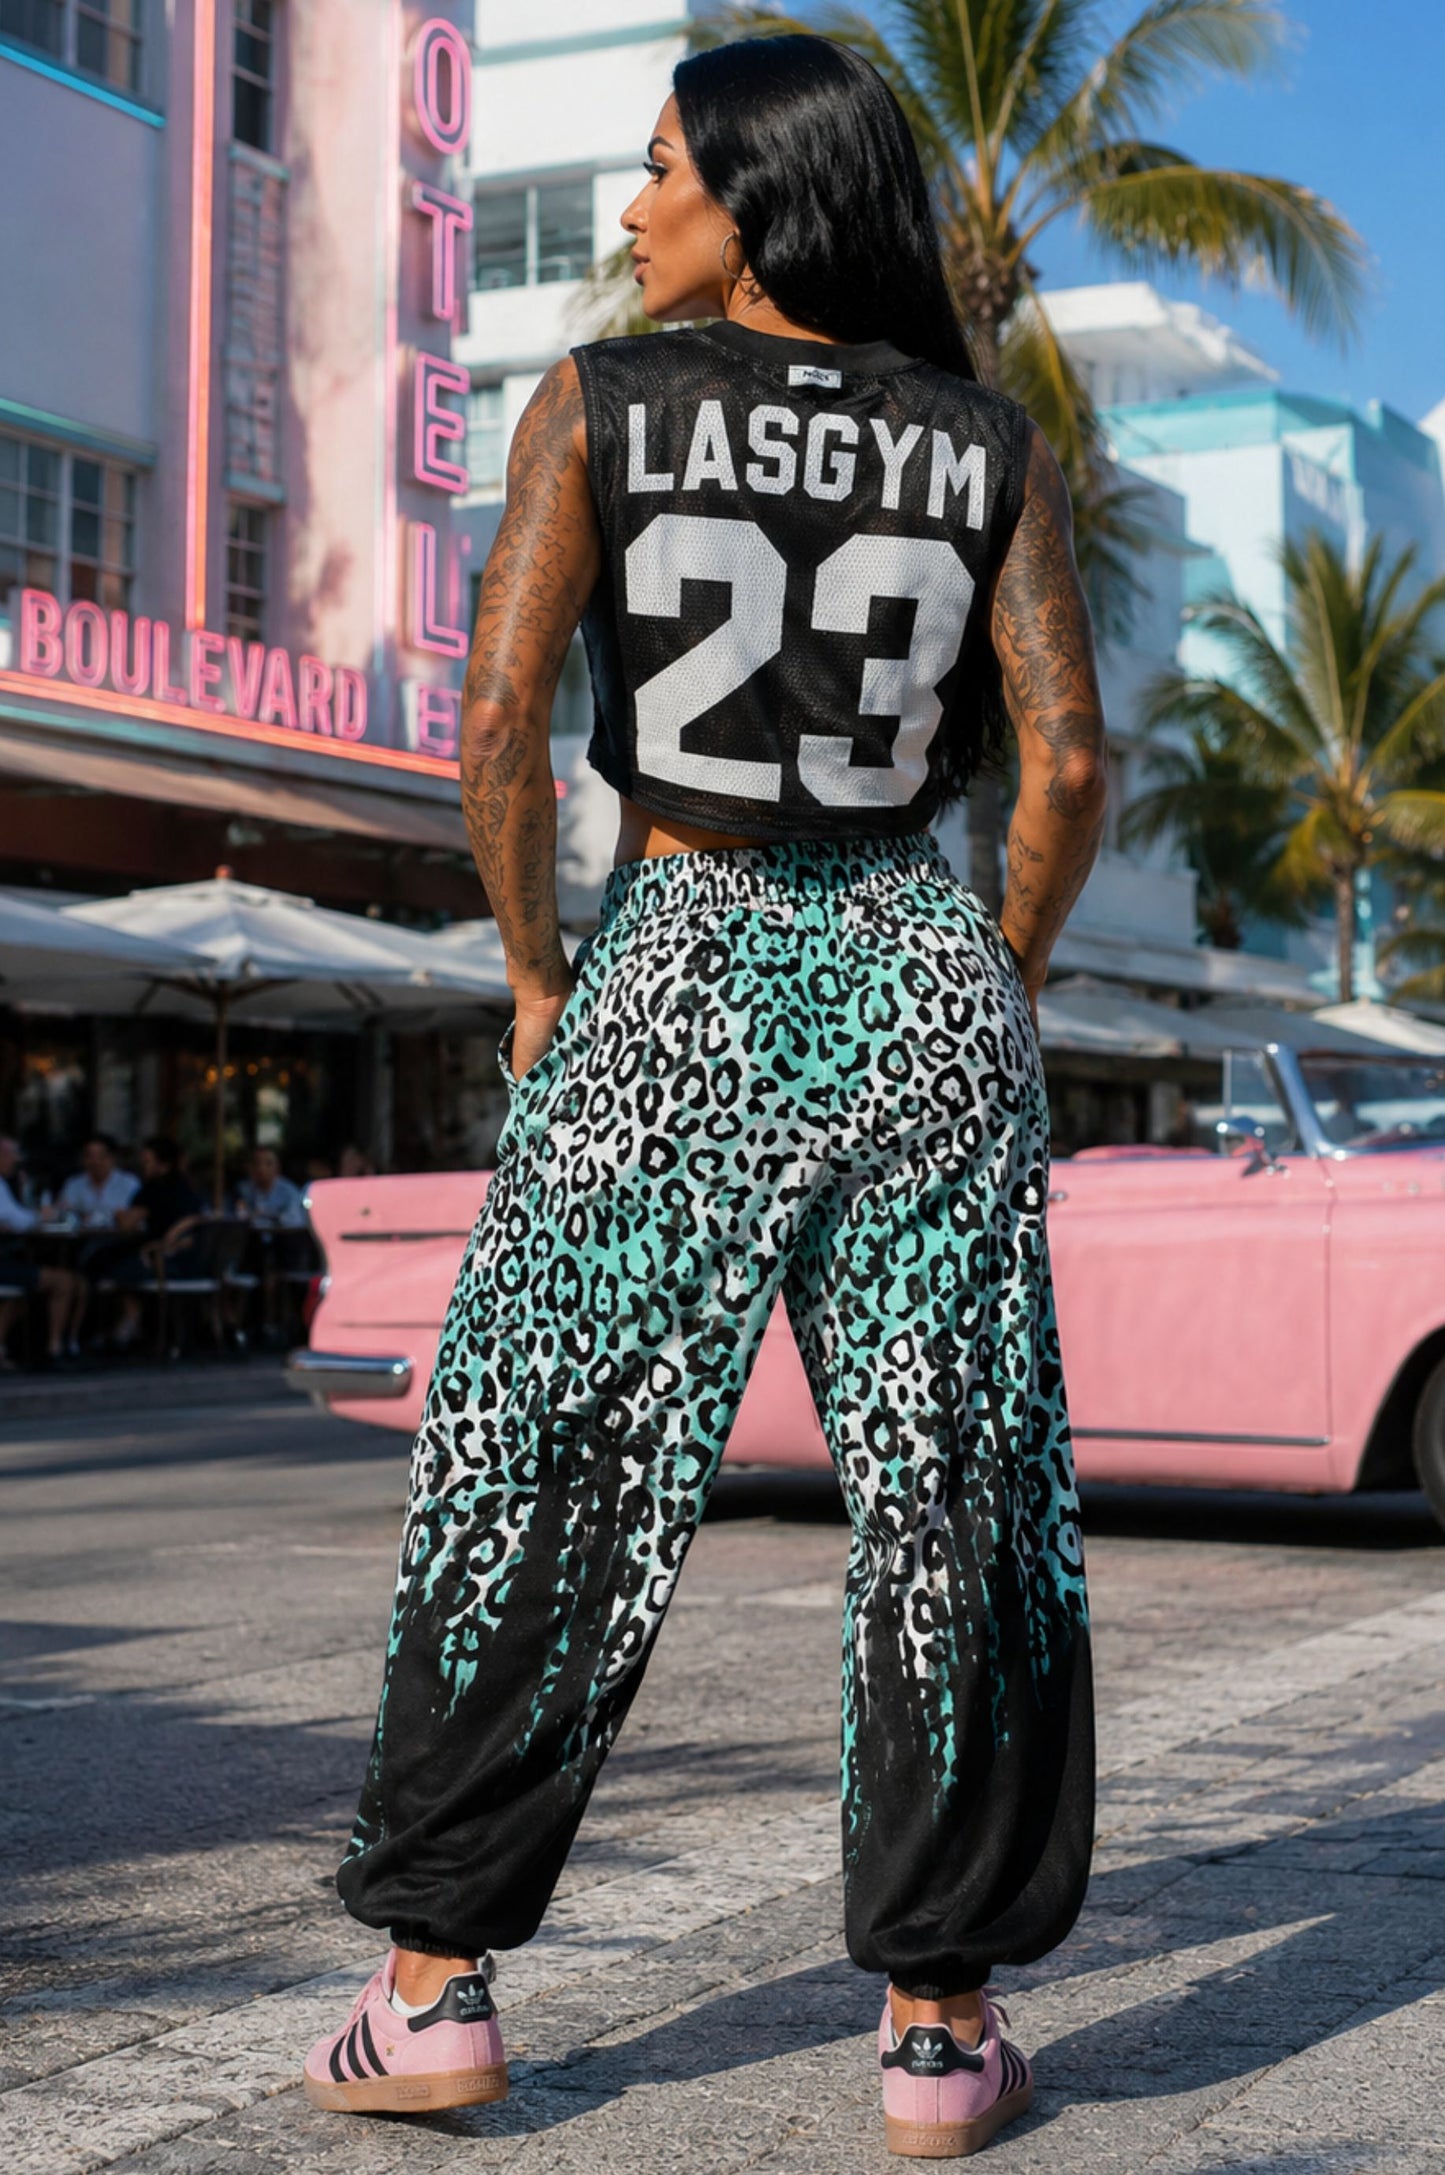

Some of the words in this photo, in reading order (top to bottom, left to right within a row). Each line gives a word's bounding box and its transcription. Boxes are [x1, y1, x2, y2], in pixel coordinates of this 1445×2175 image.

[627, 400, 987, 530] LASGYM
[20, 588, 367, 741] BOULEVARD
[625, 513, 976, 807] 23
